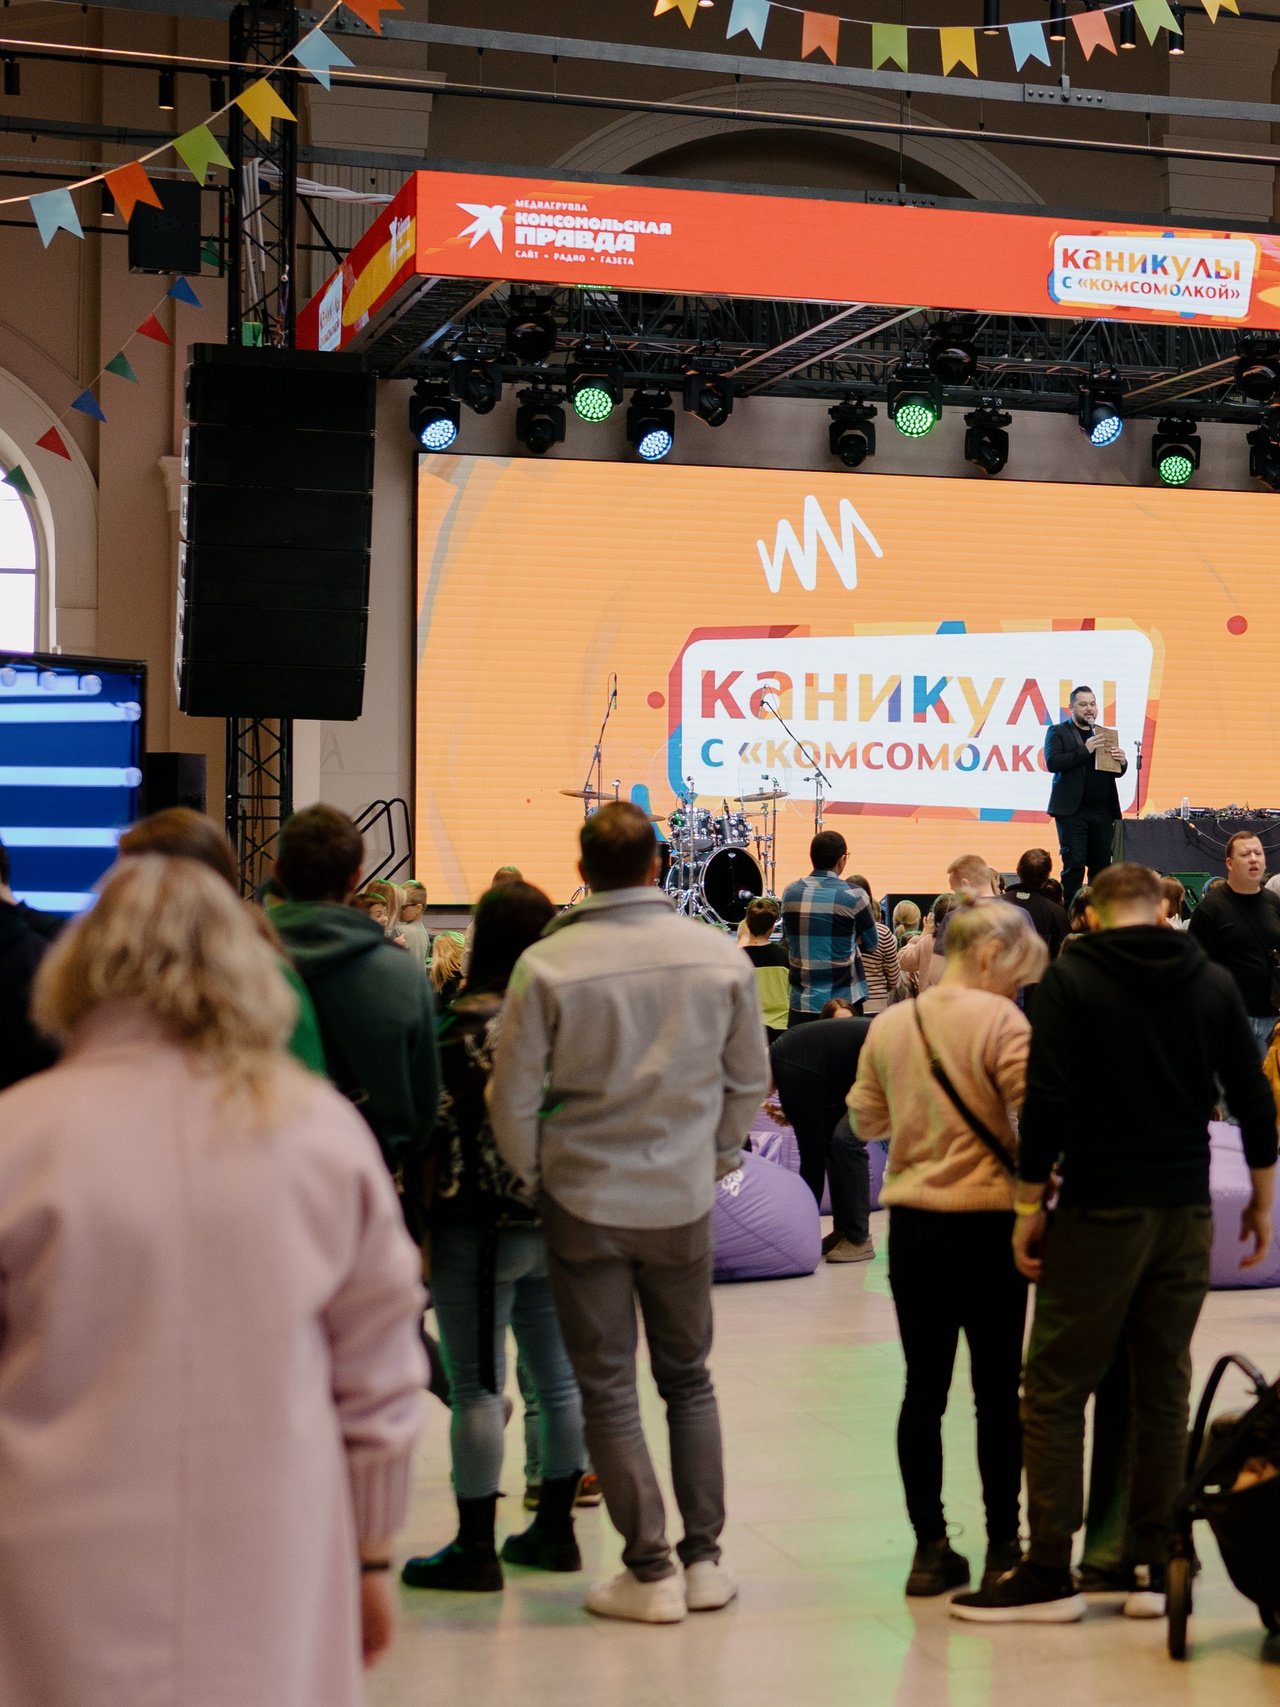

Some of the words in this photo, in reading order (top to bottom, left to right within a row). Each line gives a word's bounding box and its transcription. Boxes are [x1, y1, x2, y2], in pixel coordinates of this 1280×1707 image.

[515, 199, 588, 212] МЕДИАГРУППА
[515, 212, 672, 235] КОМСОМОЛЬСКАЯ
[515, 226, 636, 254] ПРАВДА
[515, 250, 539, 259] САЙТ
[553, 252, 586, 263] РАДИО
[600, 256, 635, 266] ГАЗЕТА
[1062, 247, 1240, 282] каникулы
